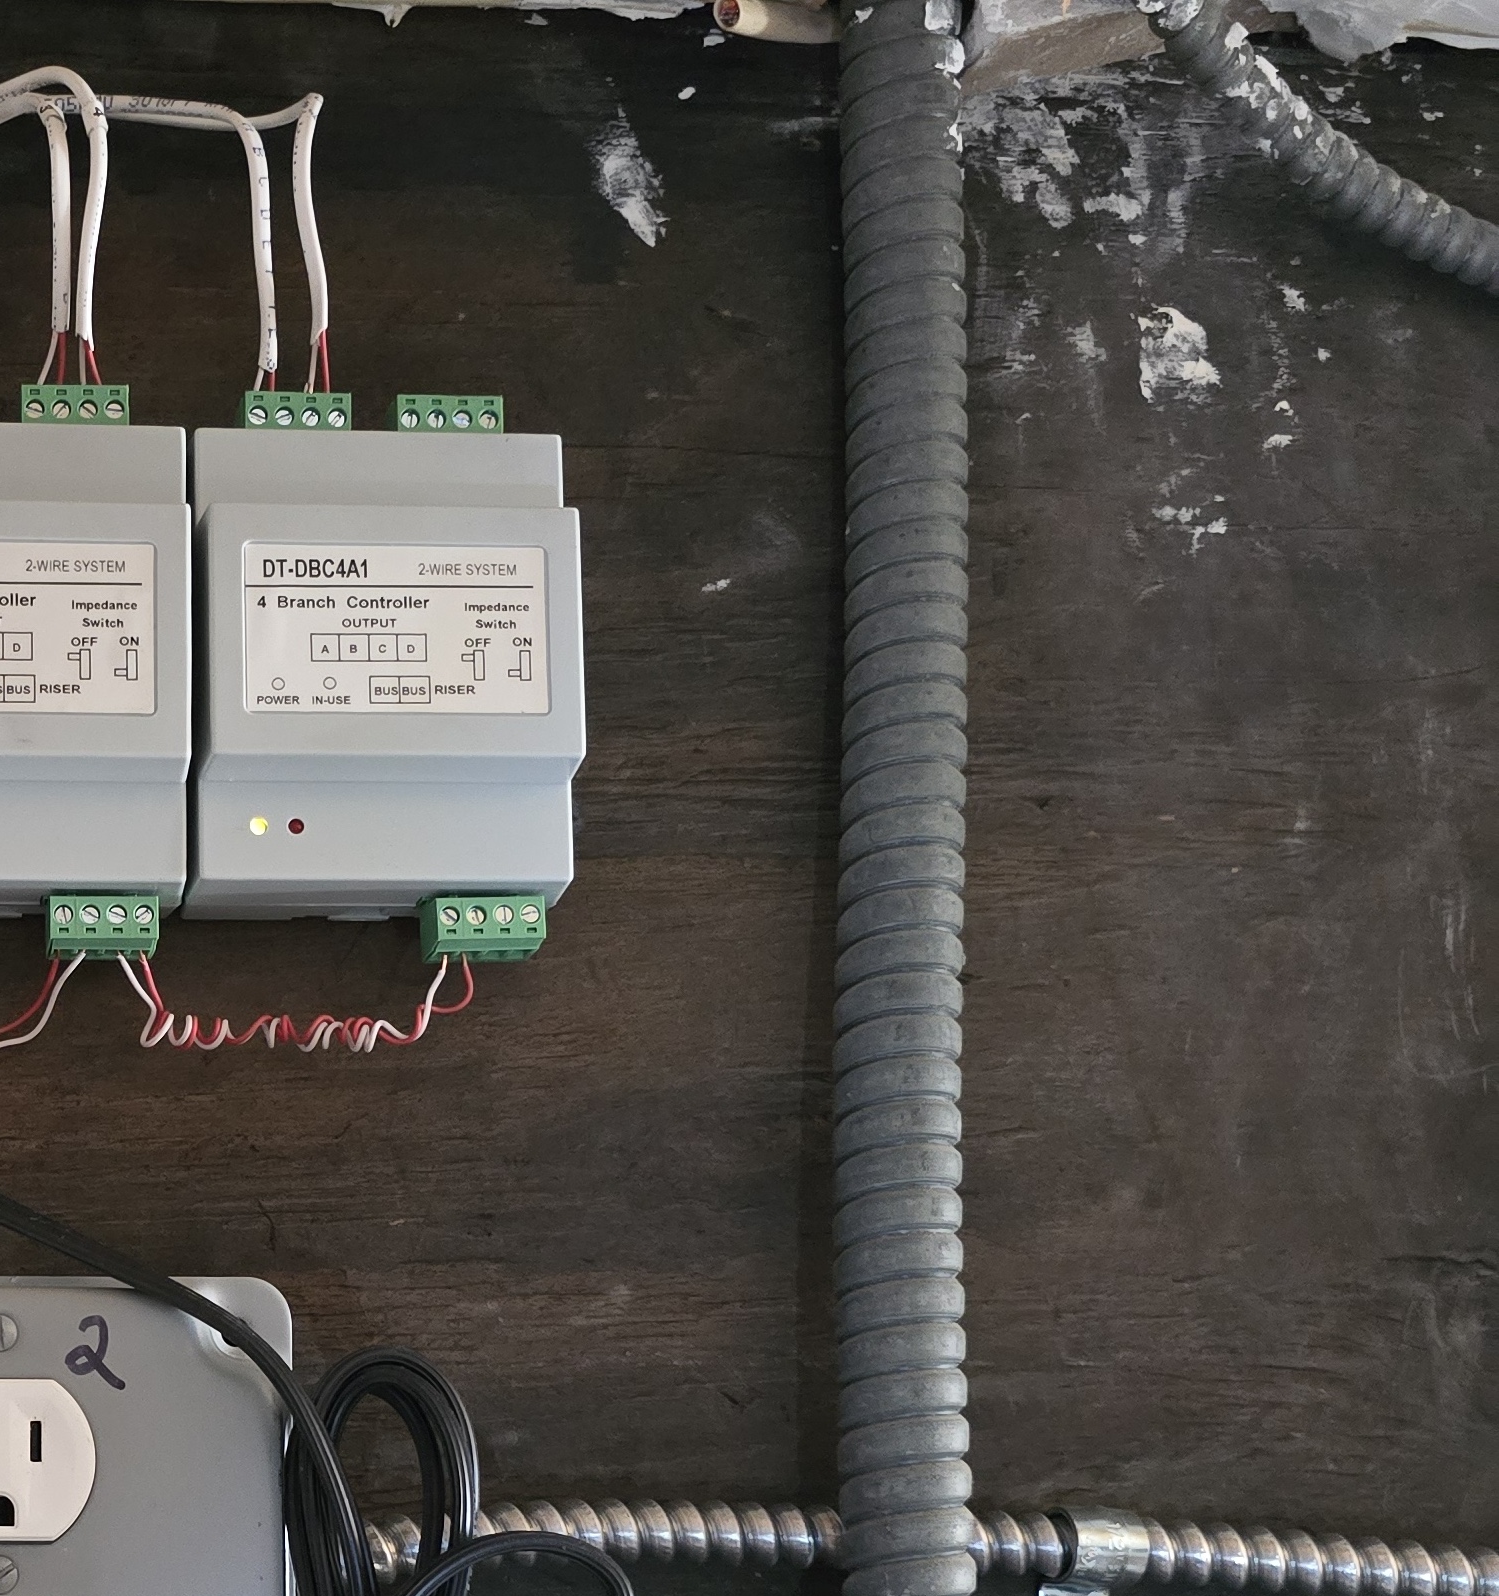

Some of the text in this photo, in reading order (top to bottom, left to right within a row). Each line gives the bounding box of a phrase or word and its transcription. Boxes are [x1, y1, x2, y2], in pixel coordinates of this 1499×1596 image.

[26, 559, 70, 572] 2-WIRE
[74, 560, 126, 573] SYSTEM
[262, 559, 517, 578] DT-DBC4A1 2-WIRE SYSTEM
[71, 600, 138, 612] Impedance
[257, 596, 429, 609] 4 Branch Controller
[464, 603, 530, 614] Impedance
[82, 618, 124, 628] Switch
[342, 618, 397, 628] OUTPUT
[475, 620, 516, 630] Switch
[13, 642, 21, 652] D
[71, 636, 139, 647] OFF ON
[464, 638, 532, 648] OFF ON
[321, 644, 415, 654] A B C D
[6, 685, 31, 695] BUS
[40, 684, 81, 694] RISER
[374, 685, 476, 696] BUS BUS RISER
[257, 696, 351, 705] POWER IN-USE
[64, 1315, 126, 1391] 2
